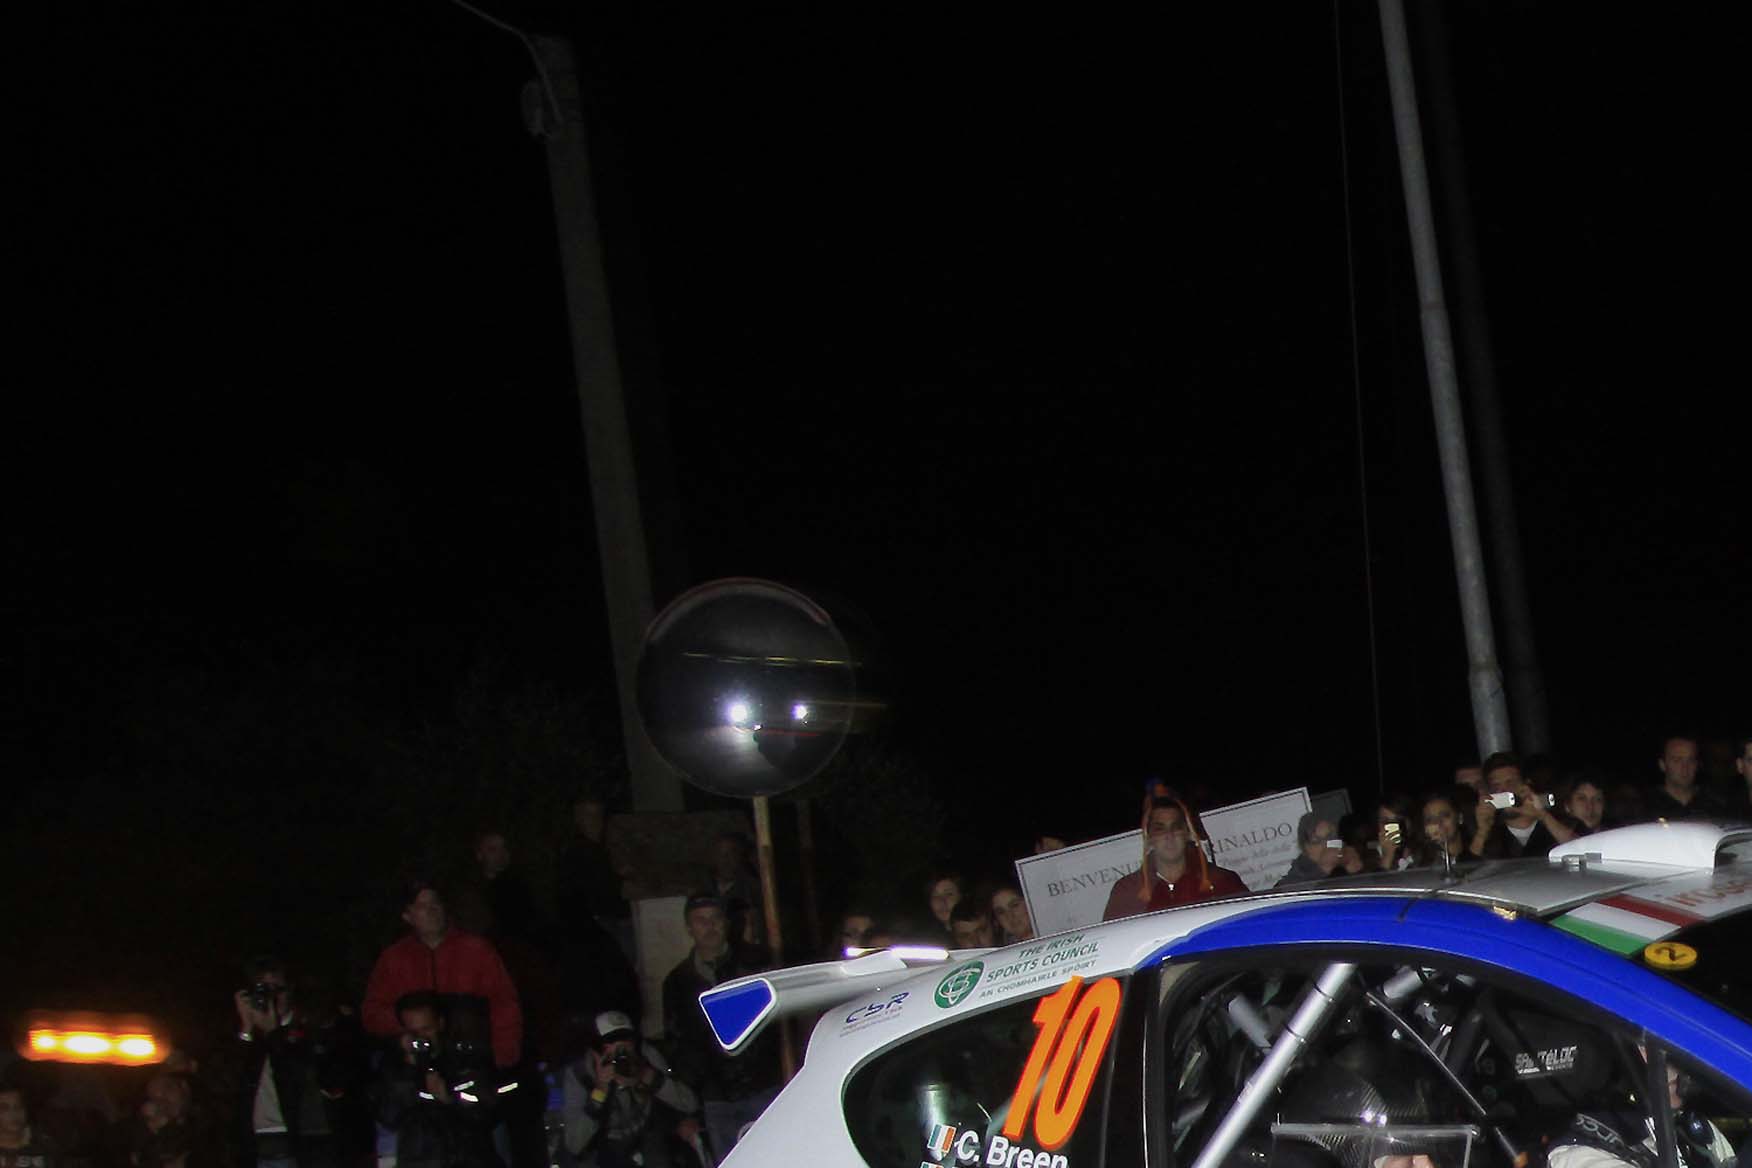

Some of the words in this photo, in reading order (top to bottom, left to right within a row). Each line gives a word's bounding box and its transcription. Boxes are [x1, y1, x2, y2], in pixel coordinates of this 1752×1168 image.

[1046, 934, 1085, 951] IRISH
[987, 959, 1038, 982] SPORTS
[1042, 943, 1099, 966] COUNCIL
[1002, 975, 1123, 1153] 10
[955, 1130, 981, 1163] C.
